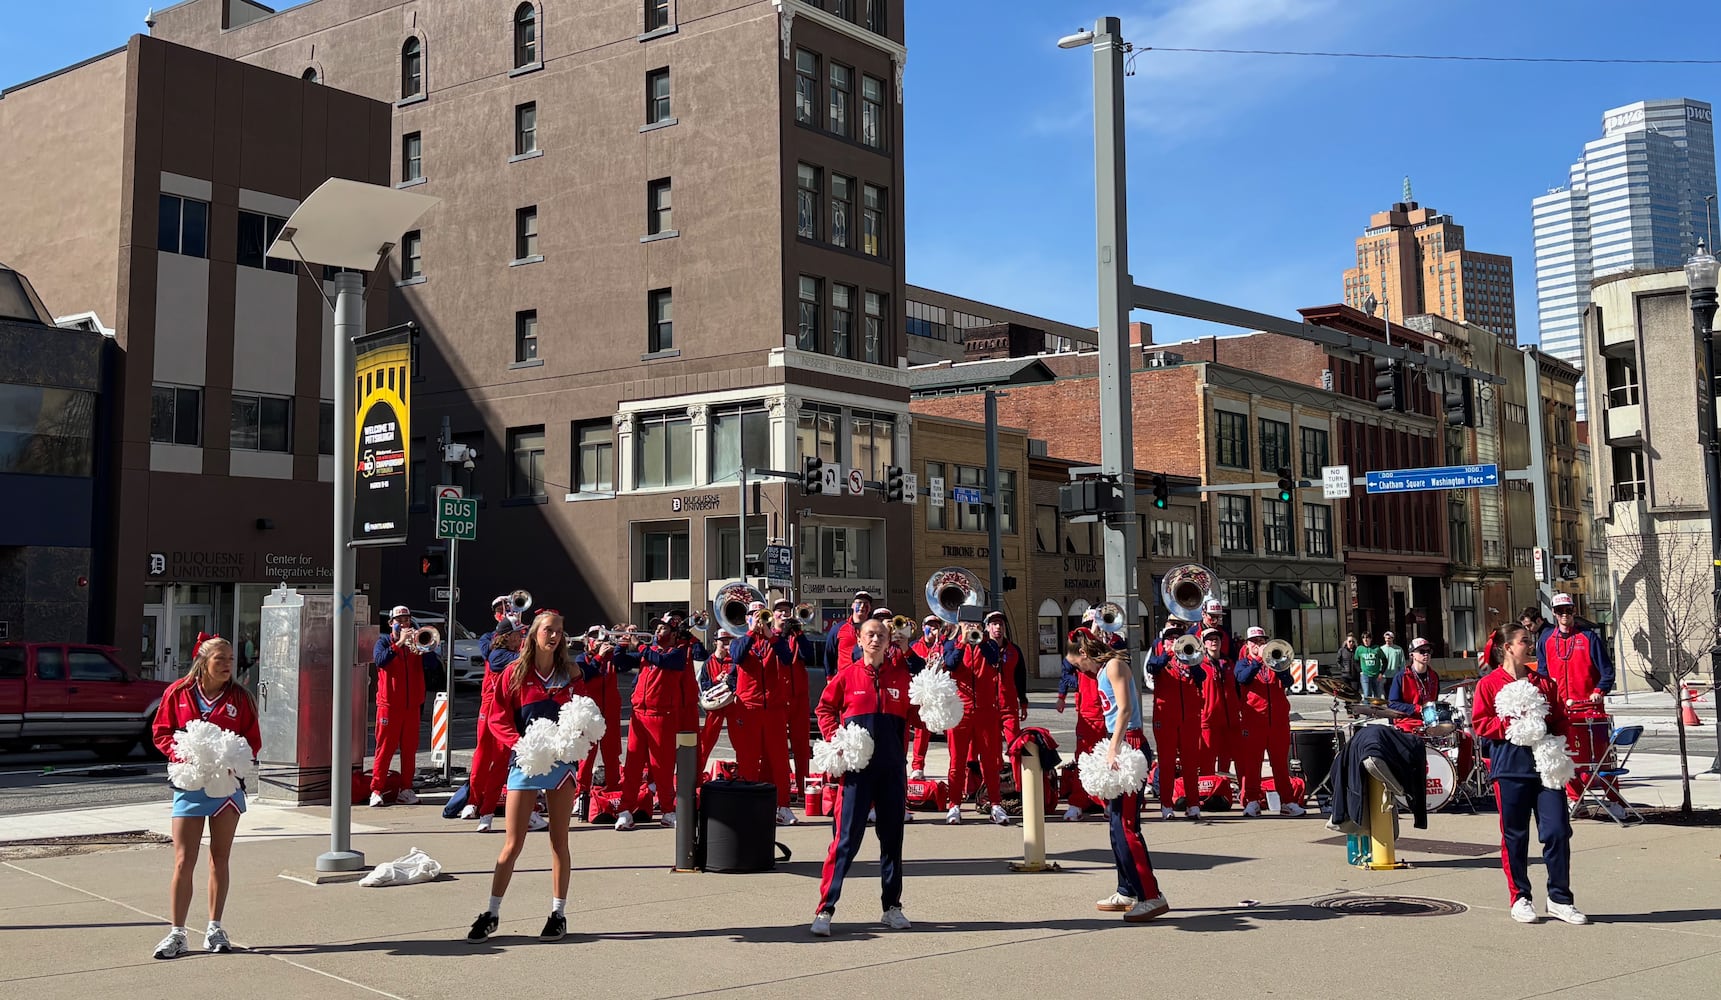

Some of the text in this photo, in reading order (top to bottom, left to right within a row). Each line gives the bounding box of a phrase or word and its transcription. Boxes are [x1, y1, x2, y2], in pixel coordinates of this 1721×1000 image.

[1605, 109, 1644, 131] pwc
[1686, 106, 1712, 121] pwc
[364, 422, 395, 435] WELCOME TO
[365, 432, 395, 445] PITTSBURGH
[905, 475, 915, 483] ONE
[1379, 475, 1484, 489] Chatham Square Washington Place
[684, 494, 720, 503] DUQUESNE
[444, 502, 471, 517] BUS
[684, 501, 720, 511] UNIVERSITY
[440, 520, 474, 534] STOP
[173, 552, 245, 566] DUQUESNE
[265, 553, 312, 564] Center for
[173, 566, 245, 577] UNIVERSITY
[265, 566, 313, 579] Integrative
[827, 585, 842, 593] Chuck
[1064, 579, 1101, 589] RESTAURANT
